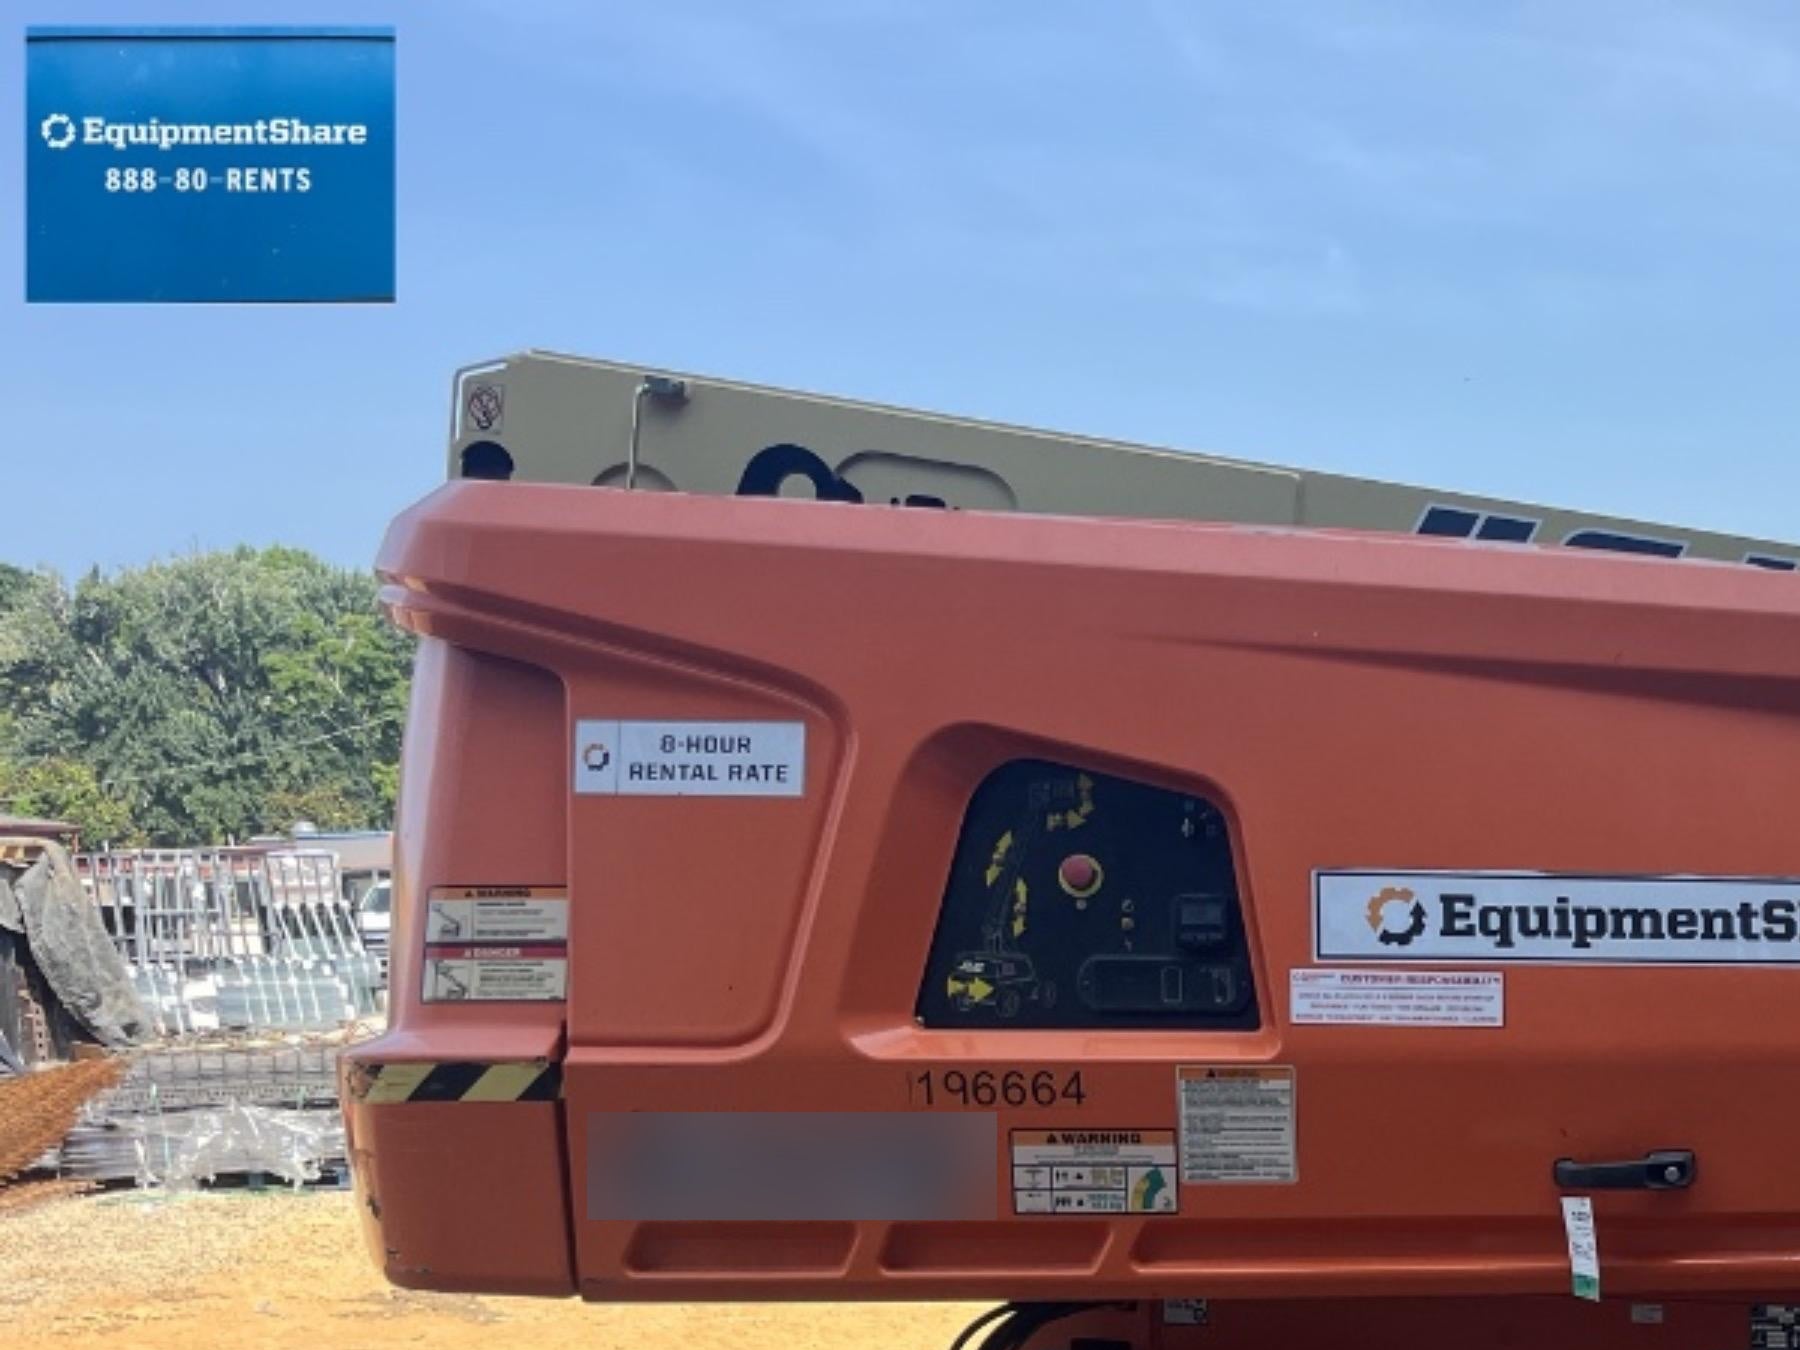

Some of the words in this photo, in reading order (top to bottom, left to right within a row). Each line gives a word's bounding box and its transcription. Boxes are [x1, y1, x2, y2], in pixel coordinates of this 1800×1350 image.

[660, 735, 751, 753] 8-HOUR
[629, 763, 718, 781] RENTAL
[729, 764, 788, 782] RATE
[917, 1070, 1087, 1106] 196664
[1061, 1131, 1142, 1145] WARNING
